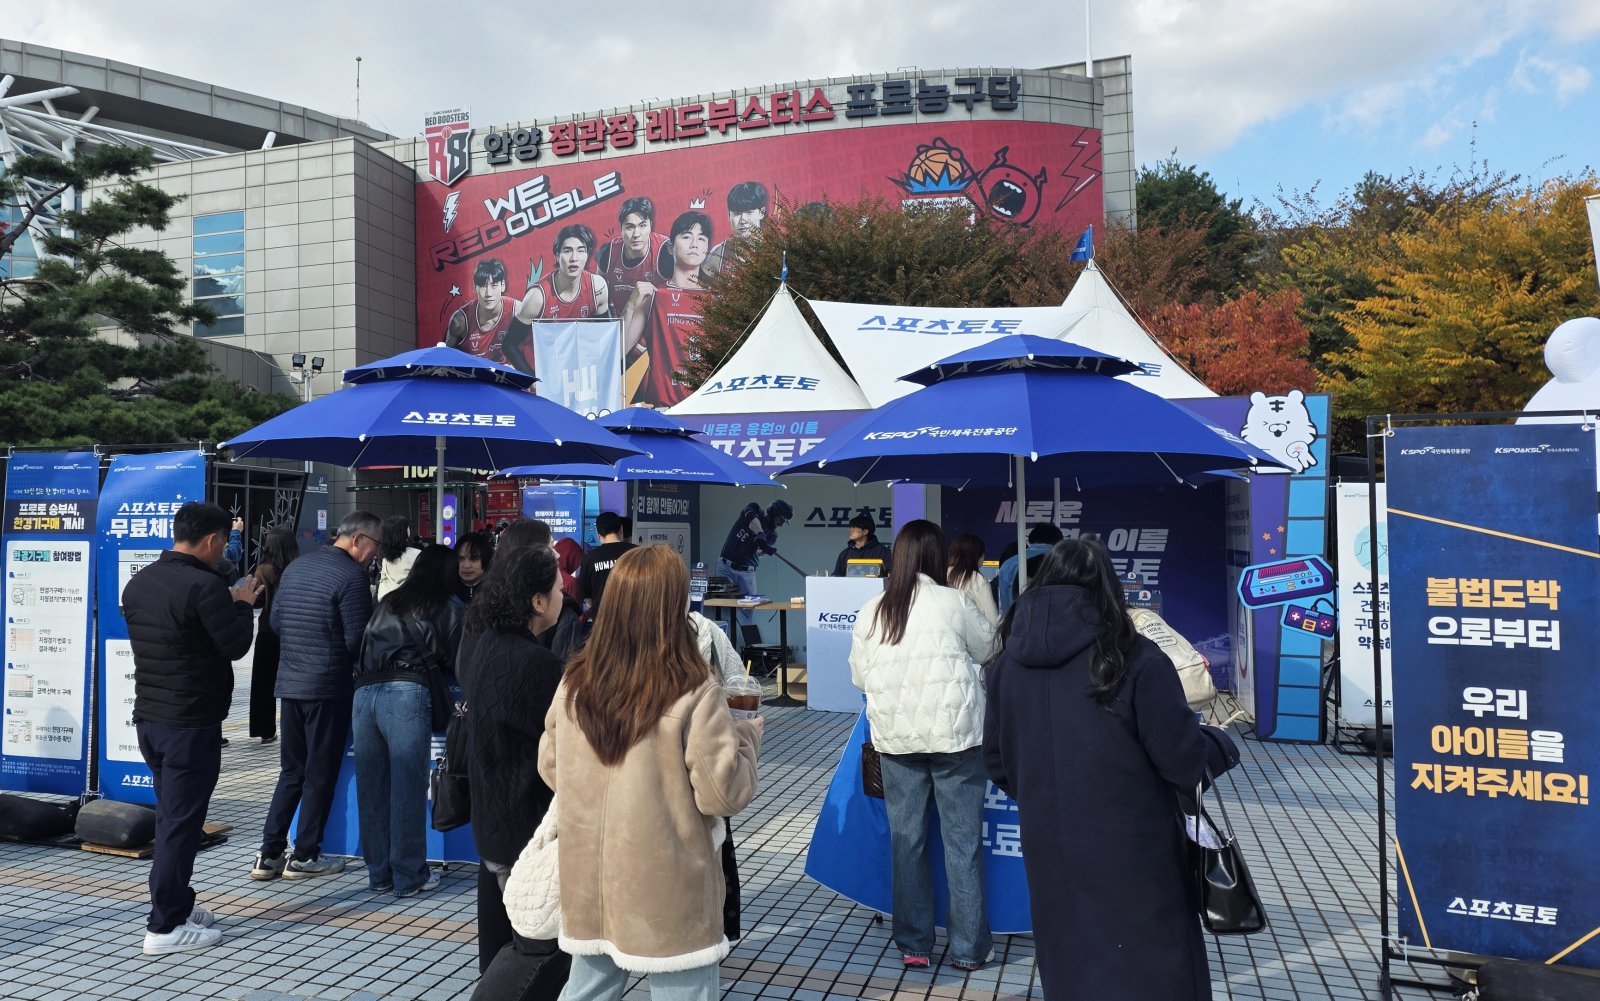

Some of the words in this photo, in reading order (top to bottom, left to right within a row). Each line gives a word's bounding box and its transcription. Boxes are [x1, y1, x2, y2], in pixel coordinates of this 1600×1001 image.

[425, 117, 437, 126] RED
[438, 112, 469, 124] BOOSTERS
[483, 127, 543, 164] 안양
[548, 113, 639, 156] 정관장
[645, 87, 835, 143] 레드부스터스
[845, 75, 1022, 118] 프로농구단
[483, 174, 552, 221] WE
[857, 315, 1022, 335] 스포츠토토
[701, 375, 821, 396] 스포츠토토
[401, 411, 516, 427] 스포츠토토
[702, 423, 742, 436] 새로운
[747, 422, 786, 436] 응원의
[790, 420, 819, 434] 이름
[863, 431, 918, 441] KSPO
[928, 426, 1018, 438] 국민체육진흥공단
[1494, 446, 1542, 454] KSPO&KSL
[19, 503, 47, 516] 프로토
[48, 503, 80, 517] 승부식,
[117, 501, 184, 516] 스포츠토토
[646, 496, 660, 515] 함께
[995, 501, 1083, 523] 새로운
[13, 516, 60, 530] 한경기구매
[61, 517, 85, 530] 개시!
[110, 517, 175, 539] 무료체
[1107, 528, 1170, 552] 이름
[52, 551, 82, 562] 참여방법
[594, 559, 618, 573] HUMA
[1425, 577, 1561, 611] 불법도박
[818, 612, 857, 624] KSPO
[1427, 615, 1561, 650] 으로부터
[1462, 687, 1528, 720] 우리
[1431, 724, 1565, 763] 아이들을
[121, 774, 154, 788] 스포츠
[1410, 762, 1589, 806] 지켜주세요!
[1446, 896, 1558, 926] 스포츠토토
